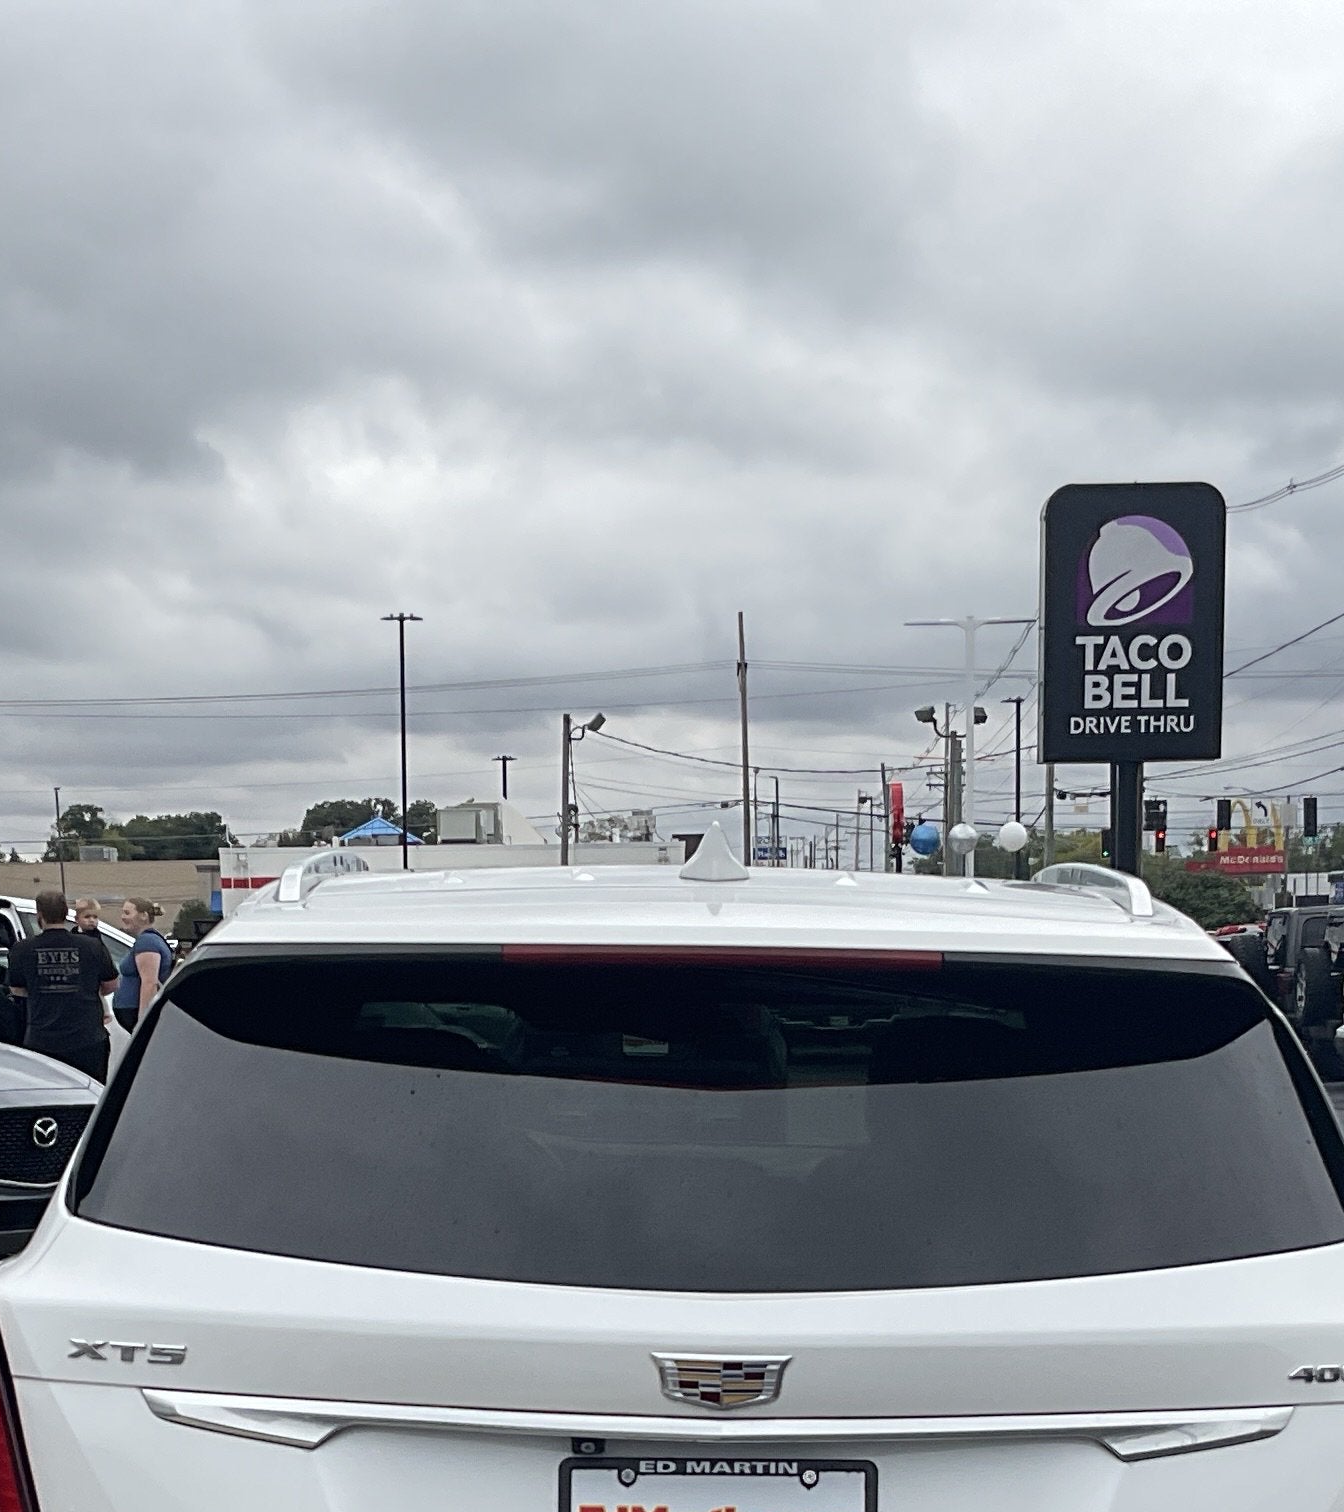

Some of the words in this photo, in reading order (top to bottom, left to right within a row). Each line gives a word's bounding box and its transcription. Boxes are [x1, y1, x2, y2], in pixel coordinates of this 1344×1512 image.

[1075, 634, 1193, 671] TACO
[1084, 673, 1189, 709] BELL
[1069, 716, 1131, 735] DRIVE
[1137, 715, 1195, 733] THRU
[37, 951, 80, 964] EYES
[67, 1338, 188, 1365] XT5
[639, 1460, 677, 1474] ED
[686, 1461, 798, 1475] MARTIN
